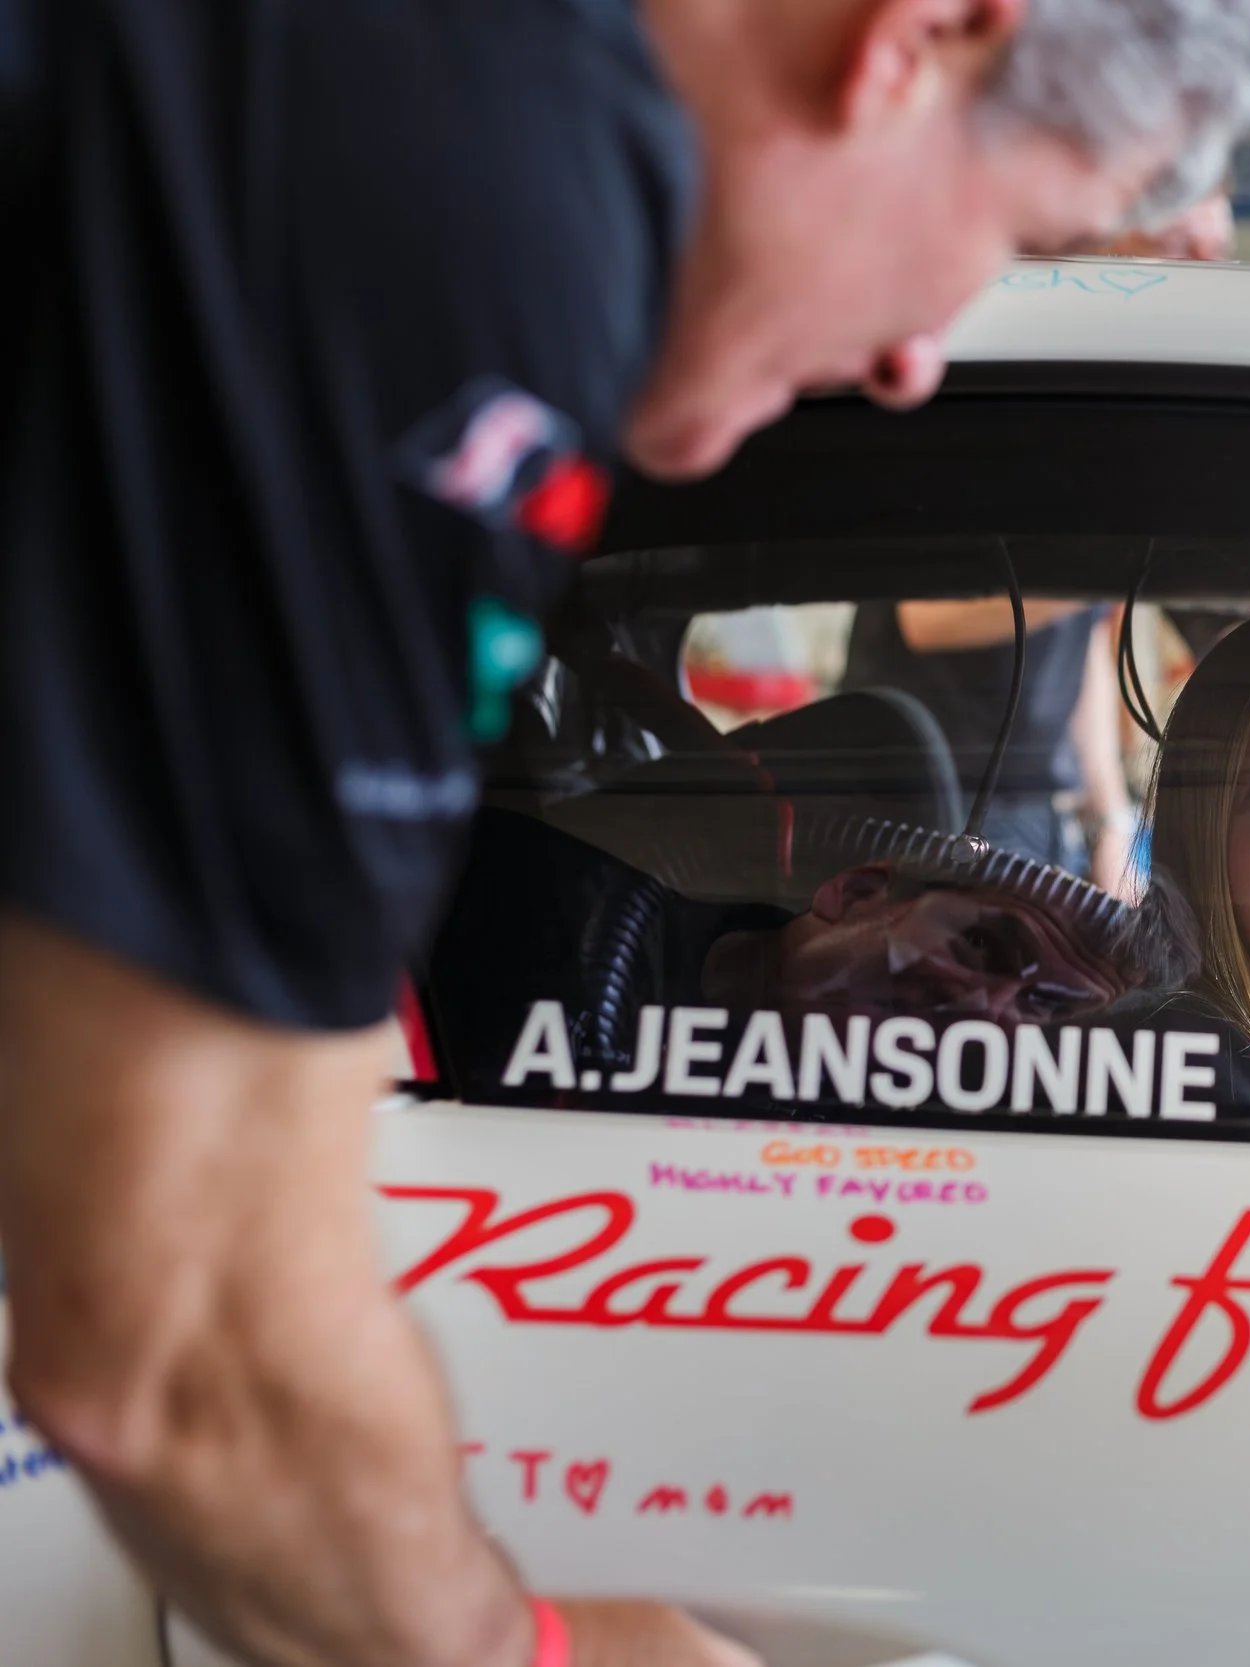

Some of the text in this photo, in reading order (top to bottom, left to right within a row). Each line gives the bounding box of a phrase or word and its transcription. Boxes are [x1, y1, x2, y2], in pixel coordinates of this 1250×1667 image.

[502, 1000, 1221, 1121] A.JEANSONNE
[649, 1162, 988, 1204] HIGHLY FAVORED
[760, 1139, 841, 1168] GOD
[378, 1184, 1115, 1416] Racing
